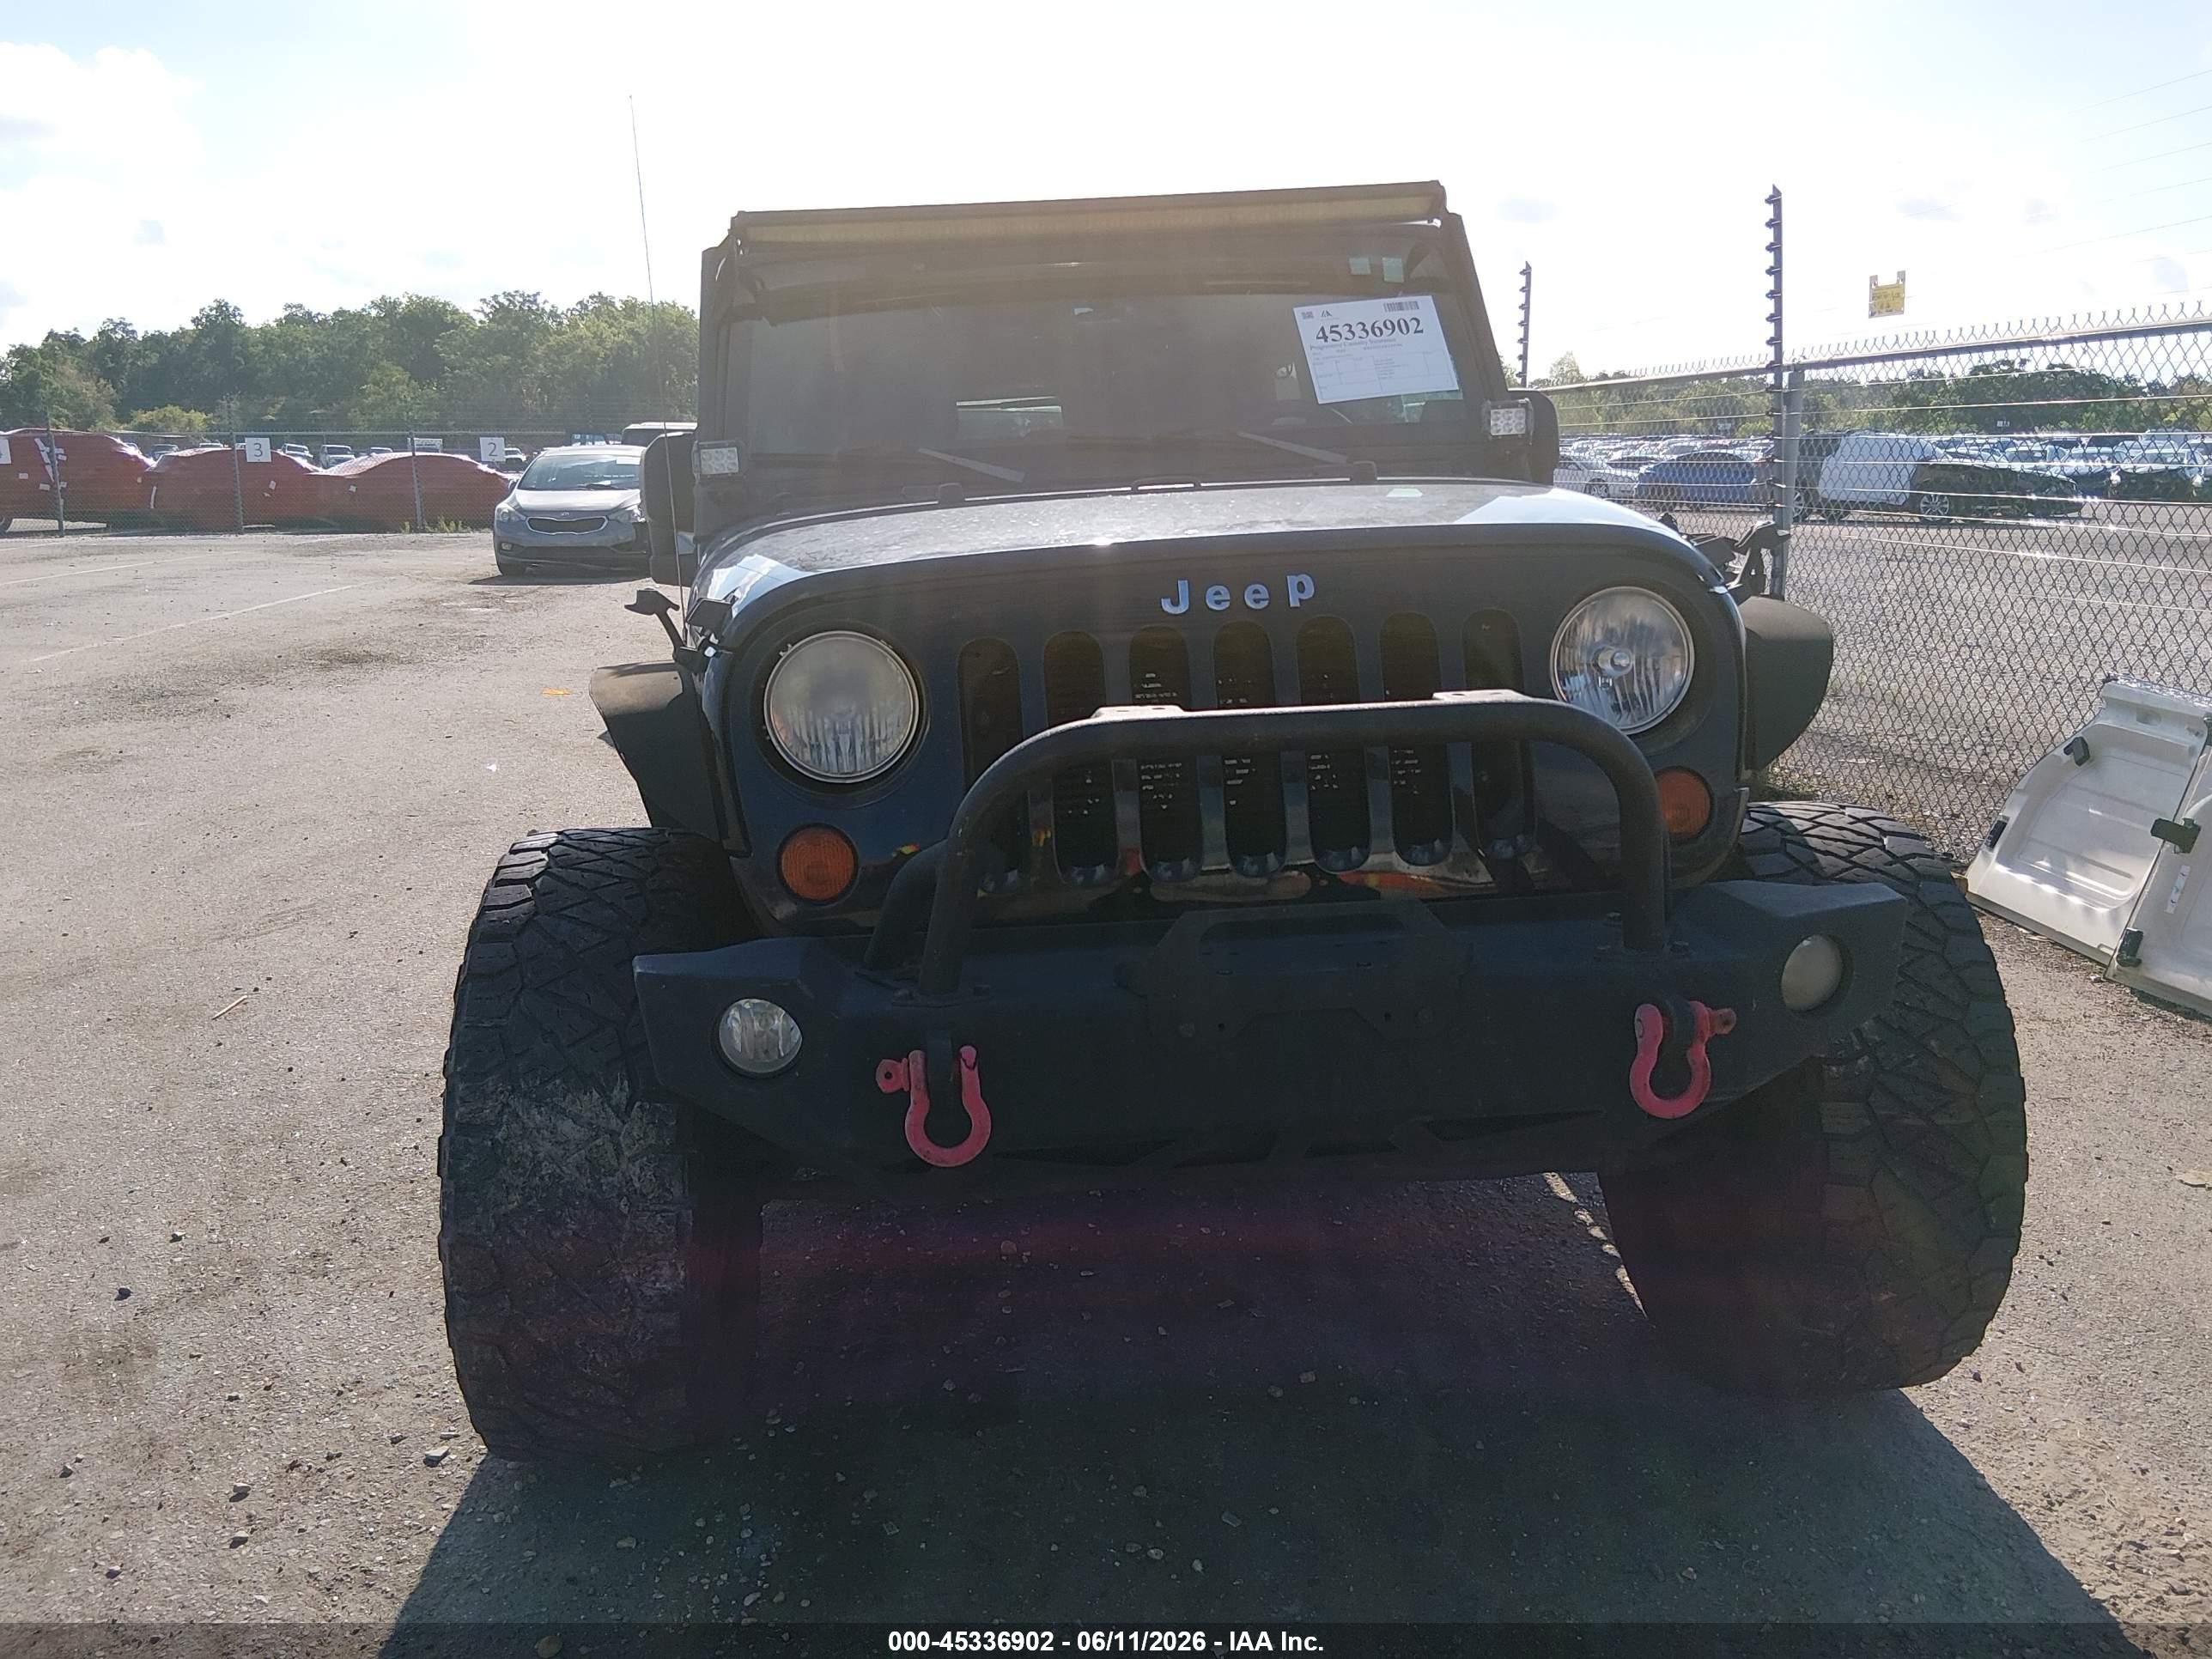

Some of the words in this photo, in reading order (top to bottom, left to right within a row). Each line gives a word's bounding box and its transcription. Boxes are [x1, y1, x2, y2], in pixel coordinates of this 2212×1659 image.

[1316, 317, 1424, 343] 45336902
[253, 442, 263, 458] 3
[488, 441, 498, 457] 2
[1161, 574, 1315, 614] Jeep
